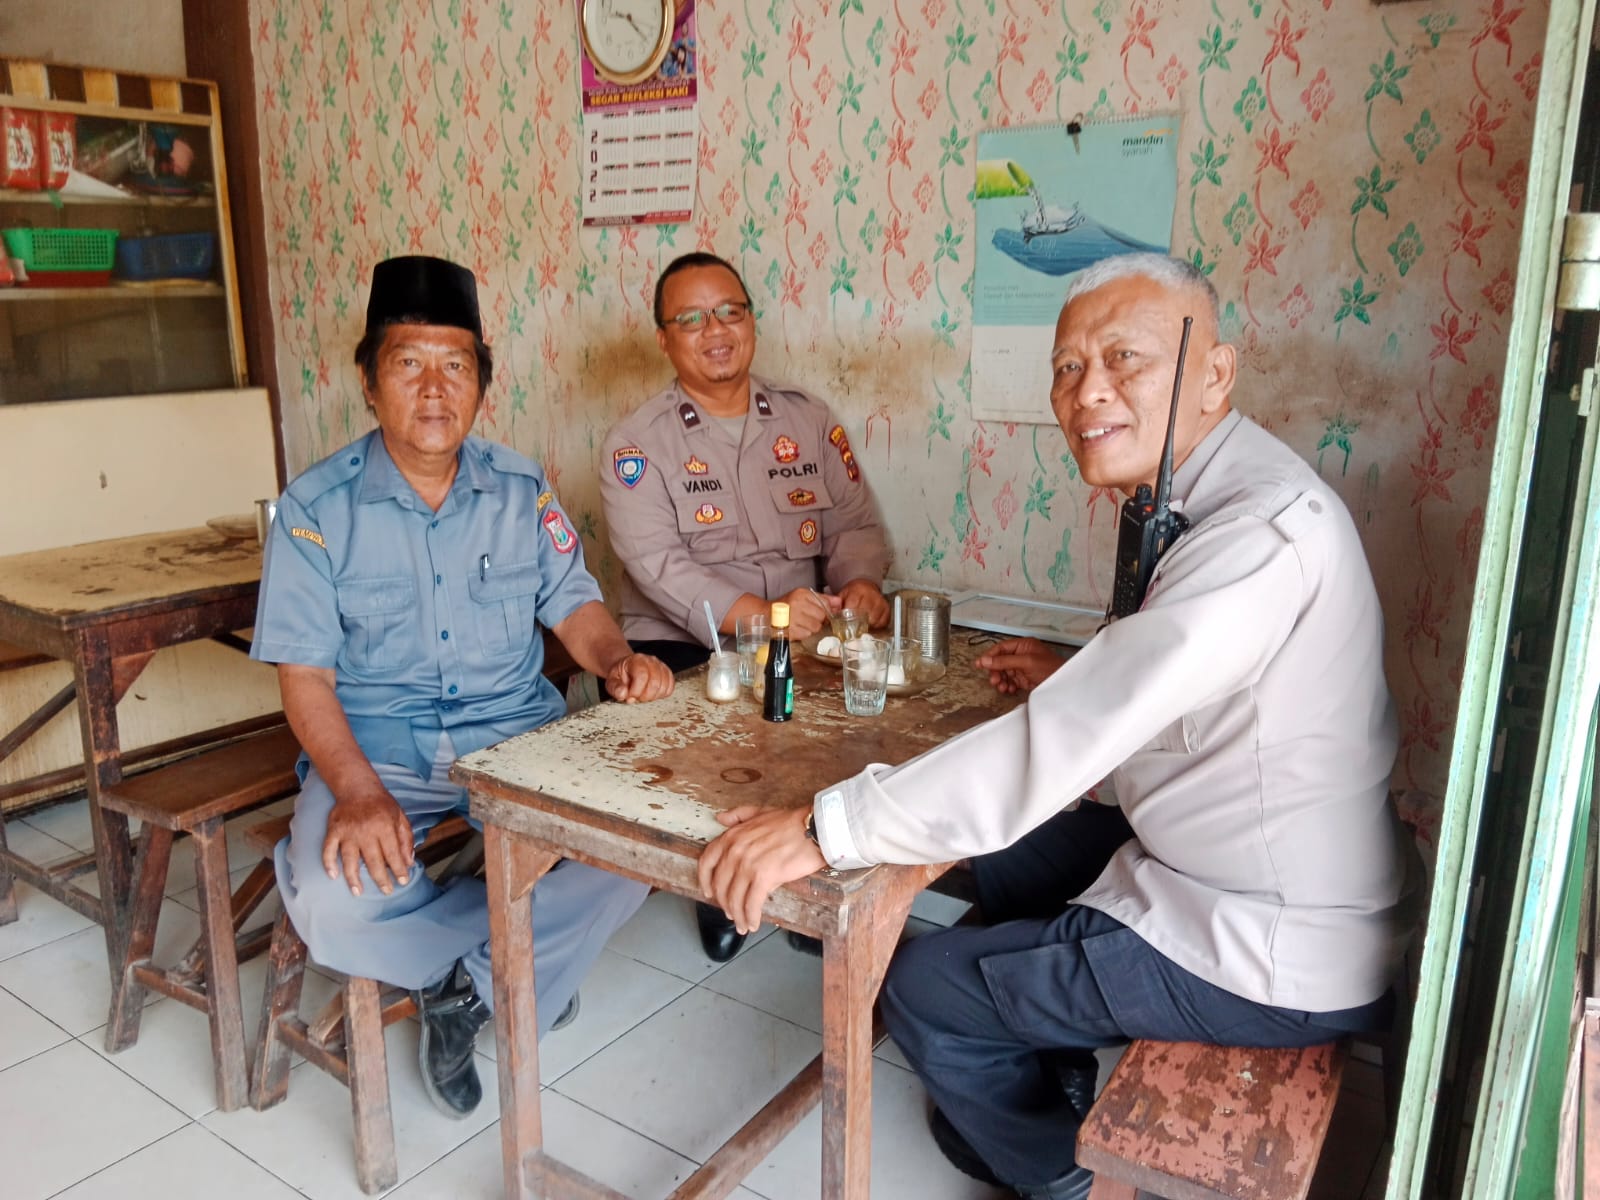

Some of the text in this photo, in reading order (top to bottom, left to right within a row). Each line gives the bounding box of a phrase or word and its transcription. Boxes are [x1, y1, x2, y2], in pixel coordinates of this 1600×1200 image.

[666, 84, 688, 97] KAKI
[768, 463, 819, 479] POLRI
[682, 479, 723, 494] VANDI
